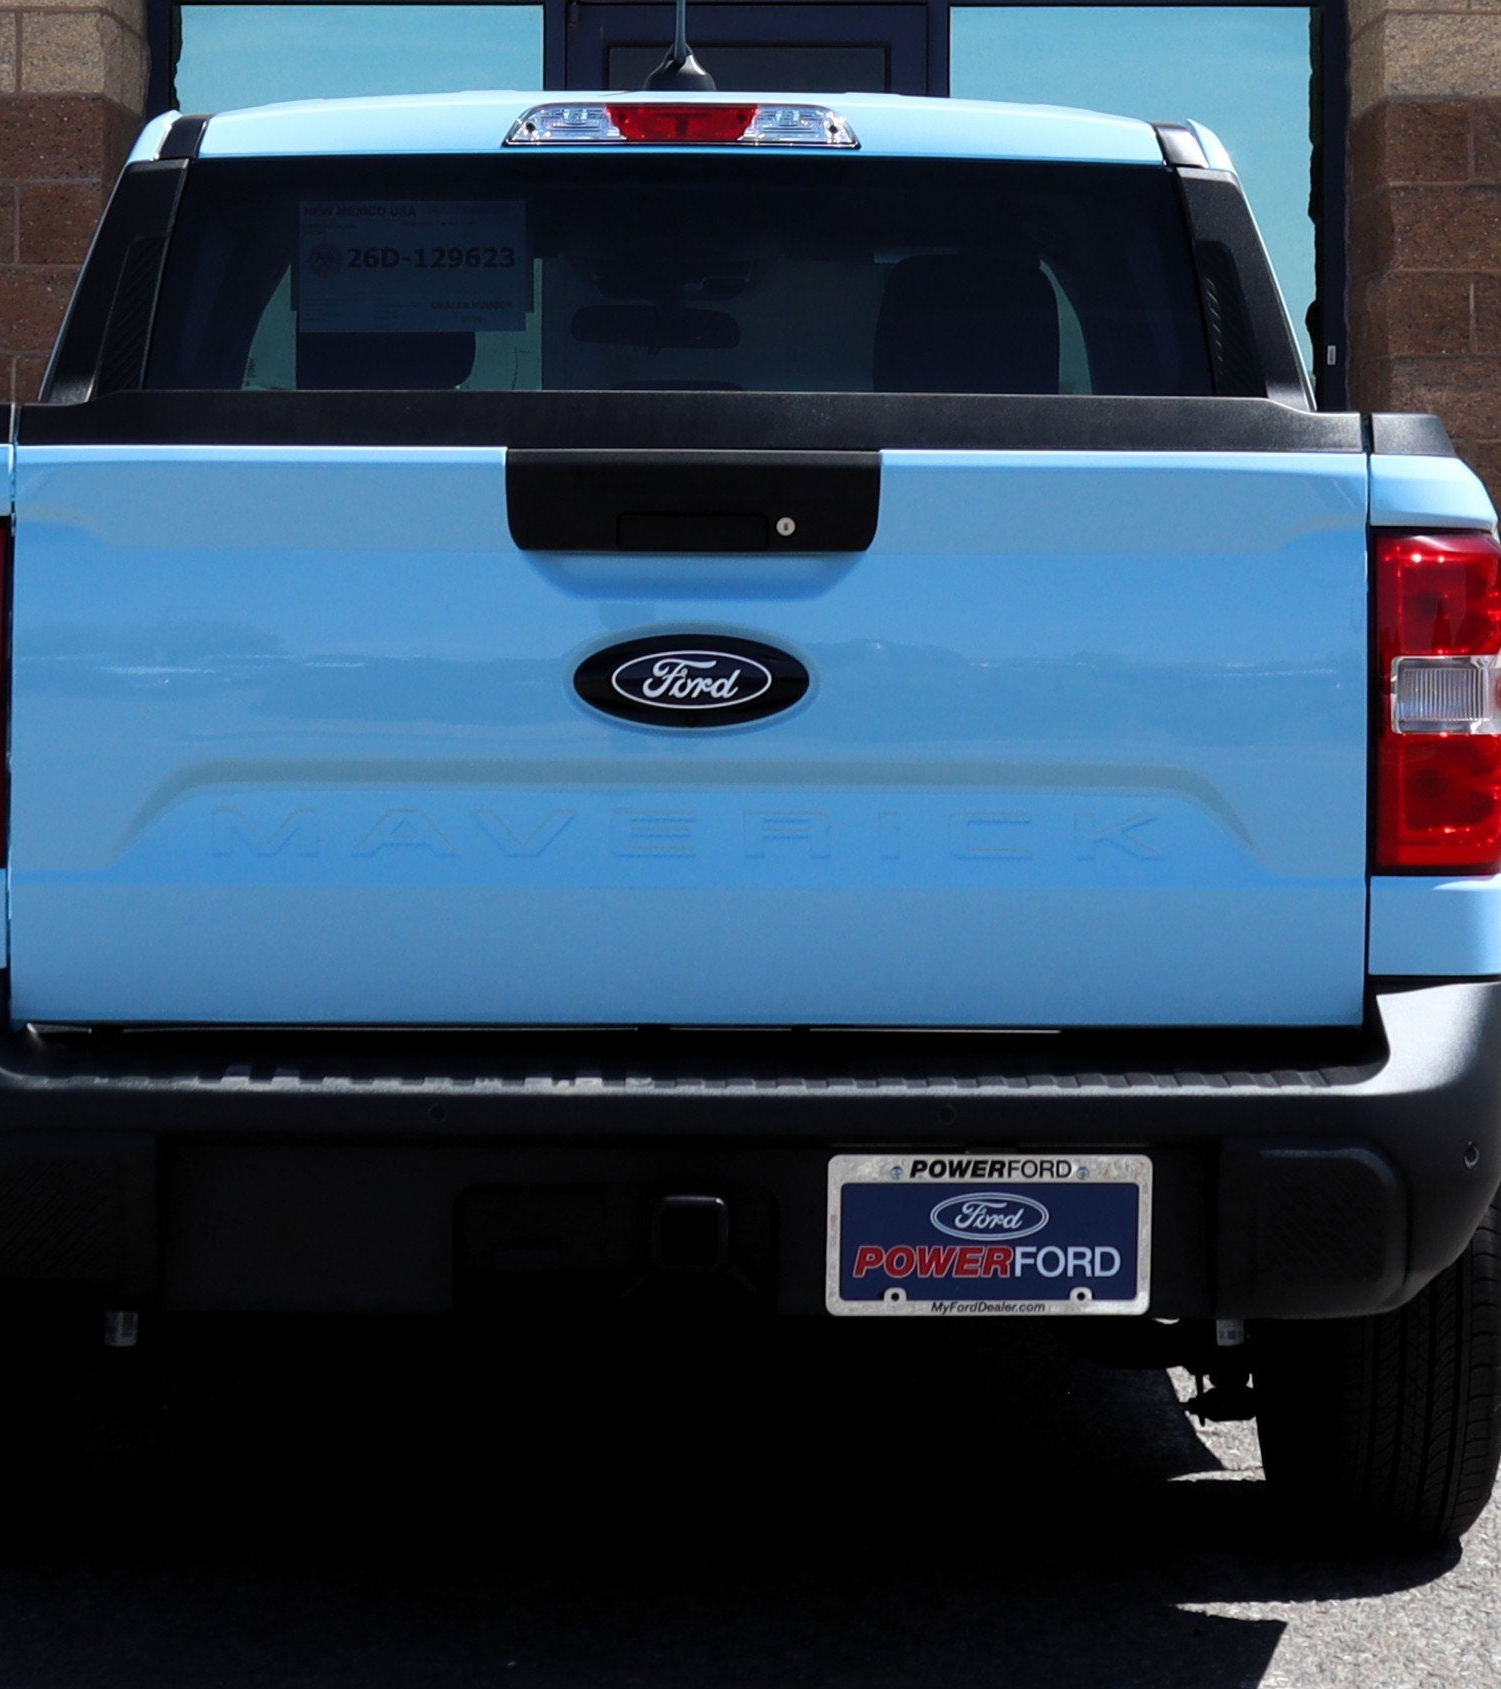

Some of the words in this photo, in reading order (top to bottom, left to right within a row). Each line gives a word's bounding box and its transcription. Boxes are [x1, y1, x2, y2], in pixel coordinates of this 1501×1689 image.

[391, 207, 417, 217] USA
[347, 247, 516, 268] 26D-129623
[642, 658, 741, 698] Ford
[210, 806, 1161, 860] MAVERICK
[909, 1159, 1073, 1179] POWERFORD
[954, 1201, 1024, 1230] Ford
[853, 1244, 1121, 1279] POWERFORD
[930, 1300, 1046, 1314] MyFordDealer.com
